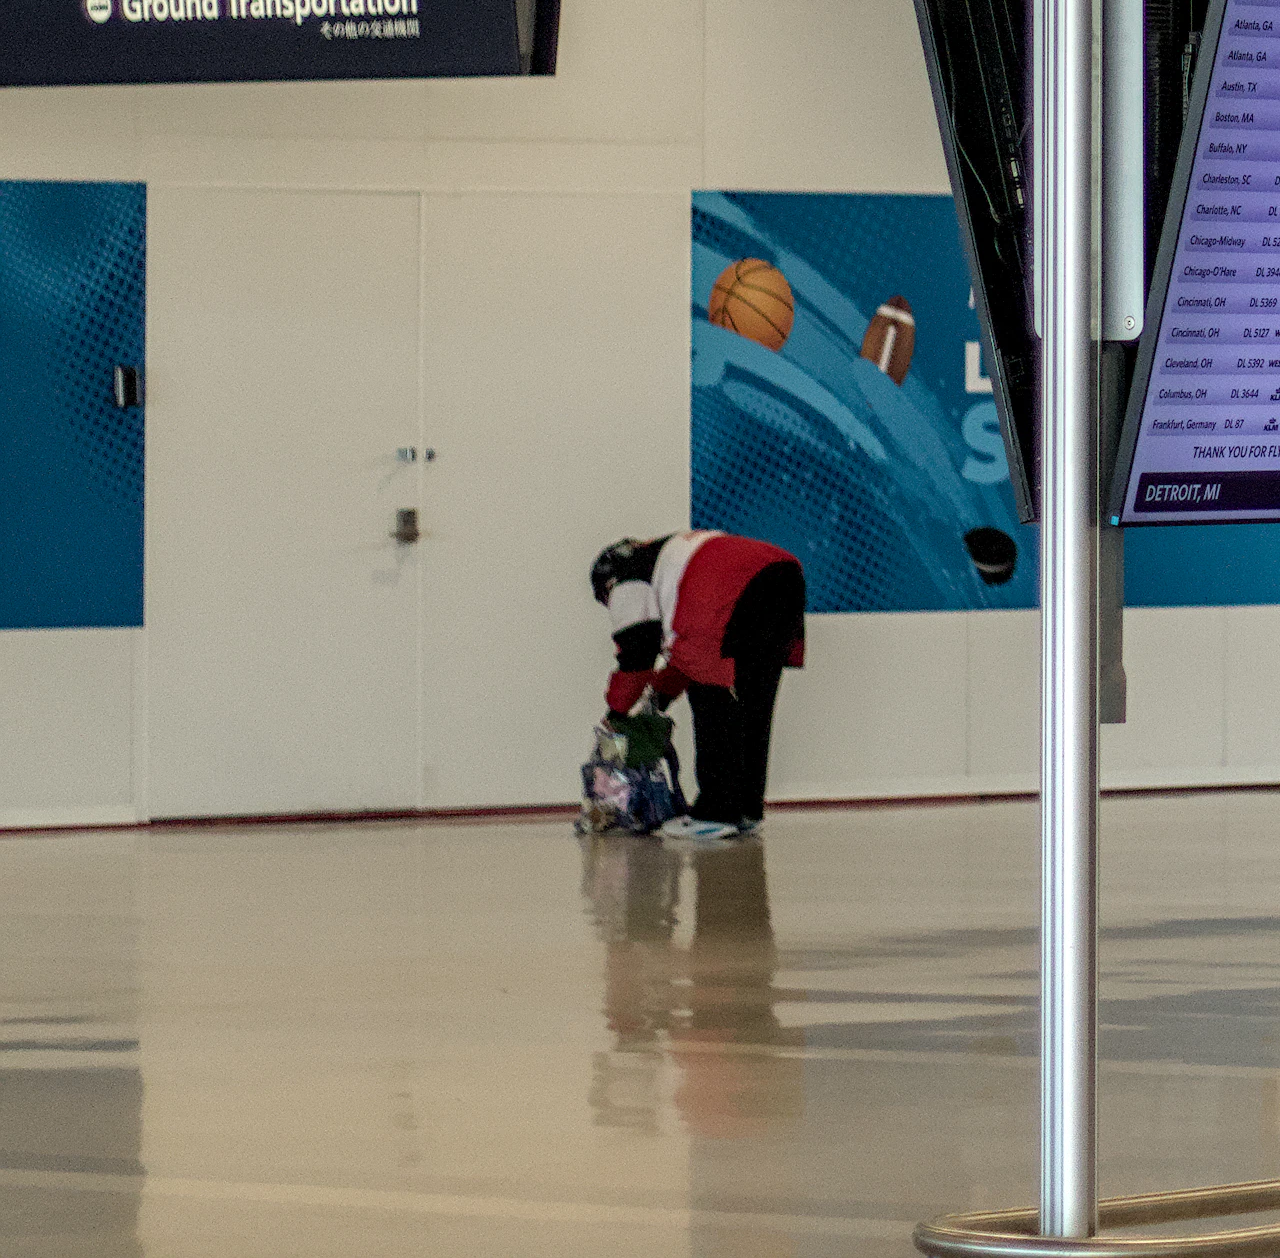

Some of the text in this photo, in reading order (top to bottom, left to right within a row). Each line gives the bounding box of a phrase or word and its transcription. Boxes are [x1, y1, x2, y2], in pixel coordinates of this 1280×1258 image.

[1194, 446, 1226, 458] THANK
[1229, 446, 1248, 458] YOU
[1249, 445, 1267, 458] FOR
[1146, 484, 1221, 503] DETROIT, MI
